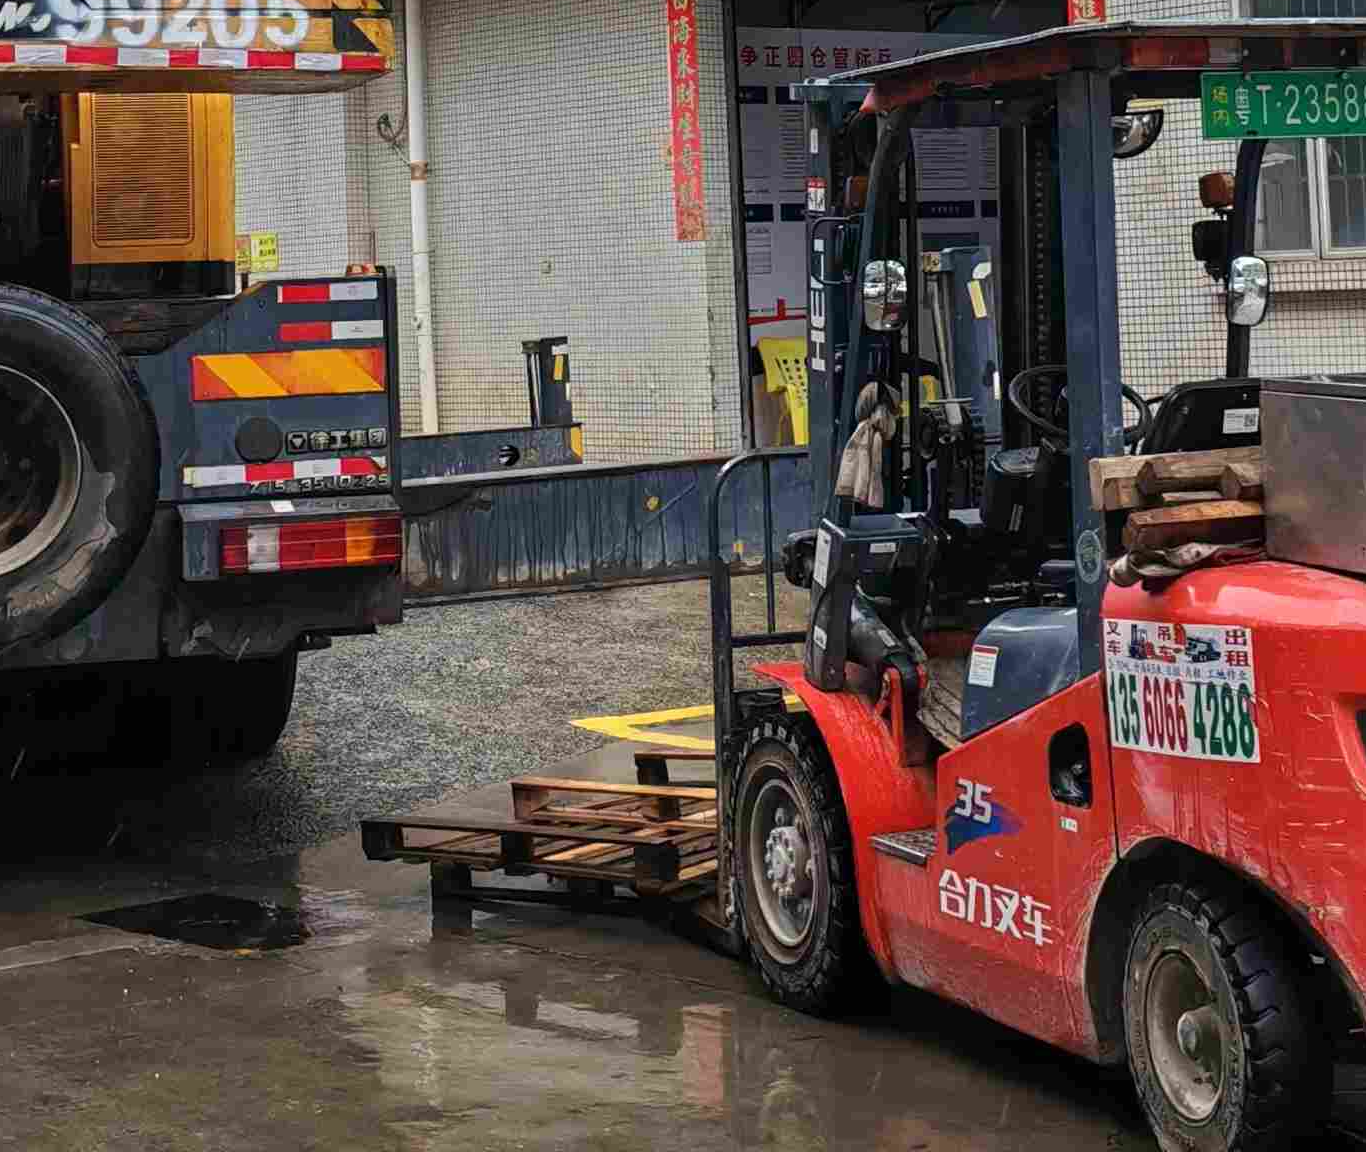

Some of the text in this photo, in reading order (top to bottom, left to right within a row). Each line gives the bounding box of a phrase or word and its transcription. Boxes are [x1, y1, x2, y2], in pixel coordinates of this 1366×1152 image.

[1106, 621, 1122, 656] 叉车
[1225, 629, 1250, 667] 出租
[1110, 672, 1256, 759] 135 6066 4288
[954, 777, 993, 824] 35
[939, 868, 1054, 947] 合力叉车
